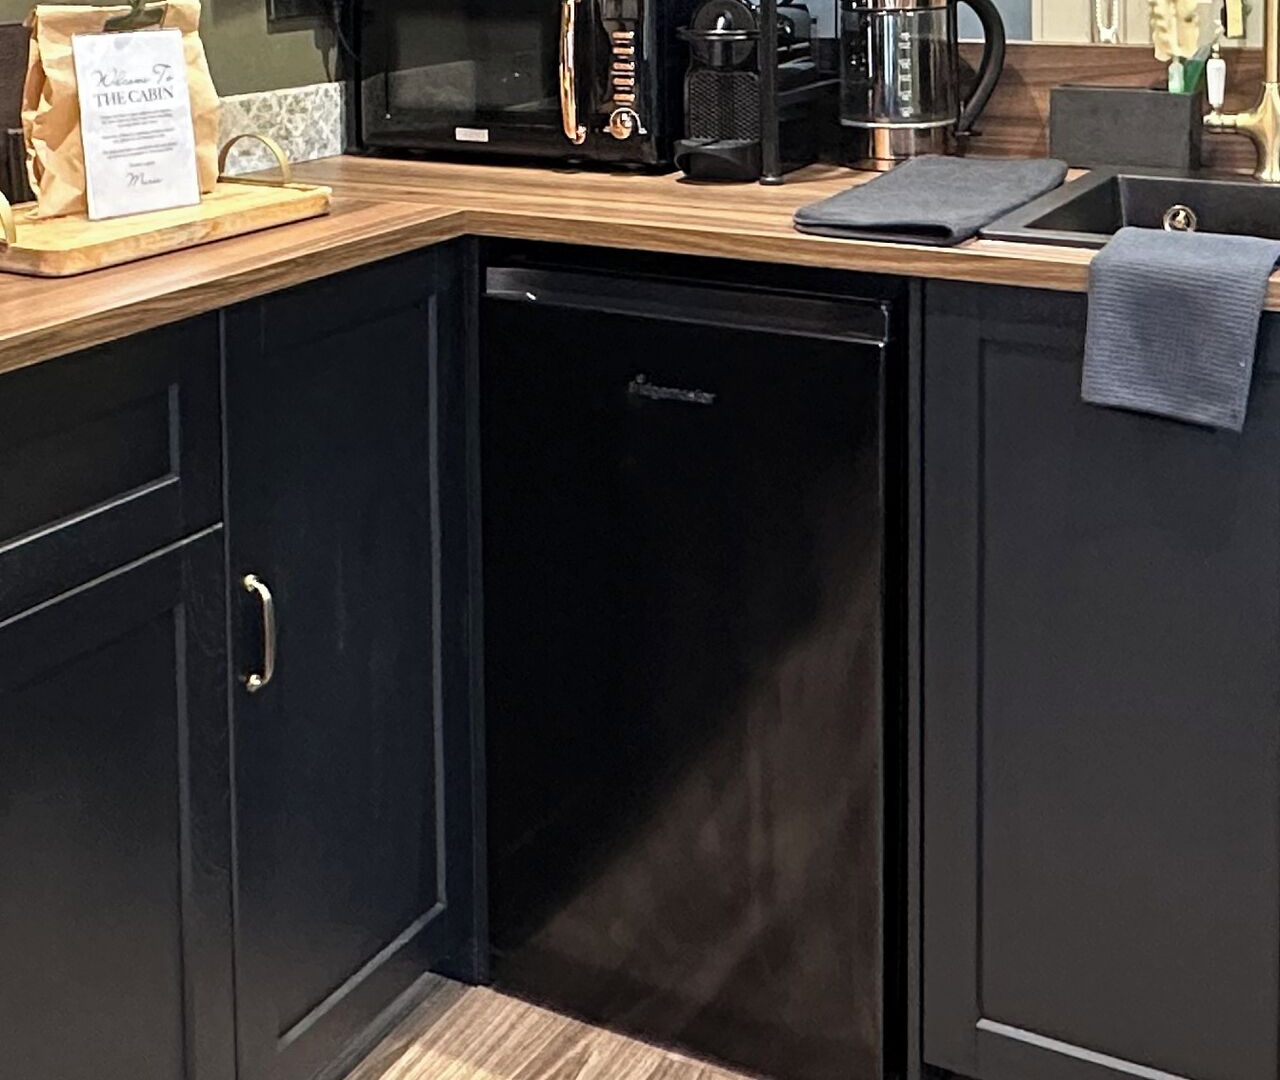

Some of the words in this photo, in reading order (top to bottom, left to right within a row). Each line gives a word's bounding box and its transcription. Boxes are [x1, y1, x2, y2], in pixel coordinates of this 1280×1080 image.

[91, 68, 150, 87] Welcome
[152, 63, 175, 85] To
[94, 92, 127, 107] THE
[128, 85, 174, 103] CABIN
